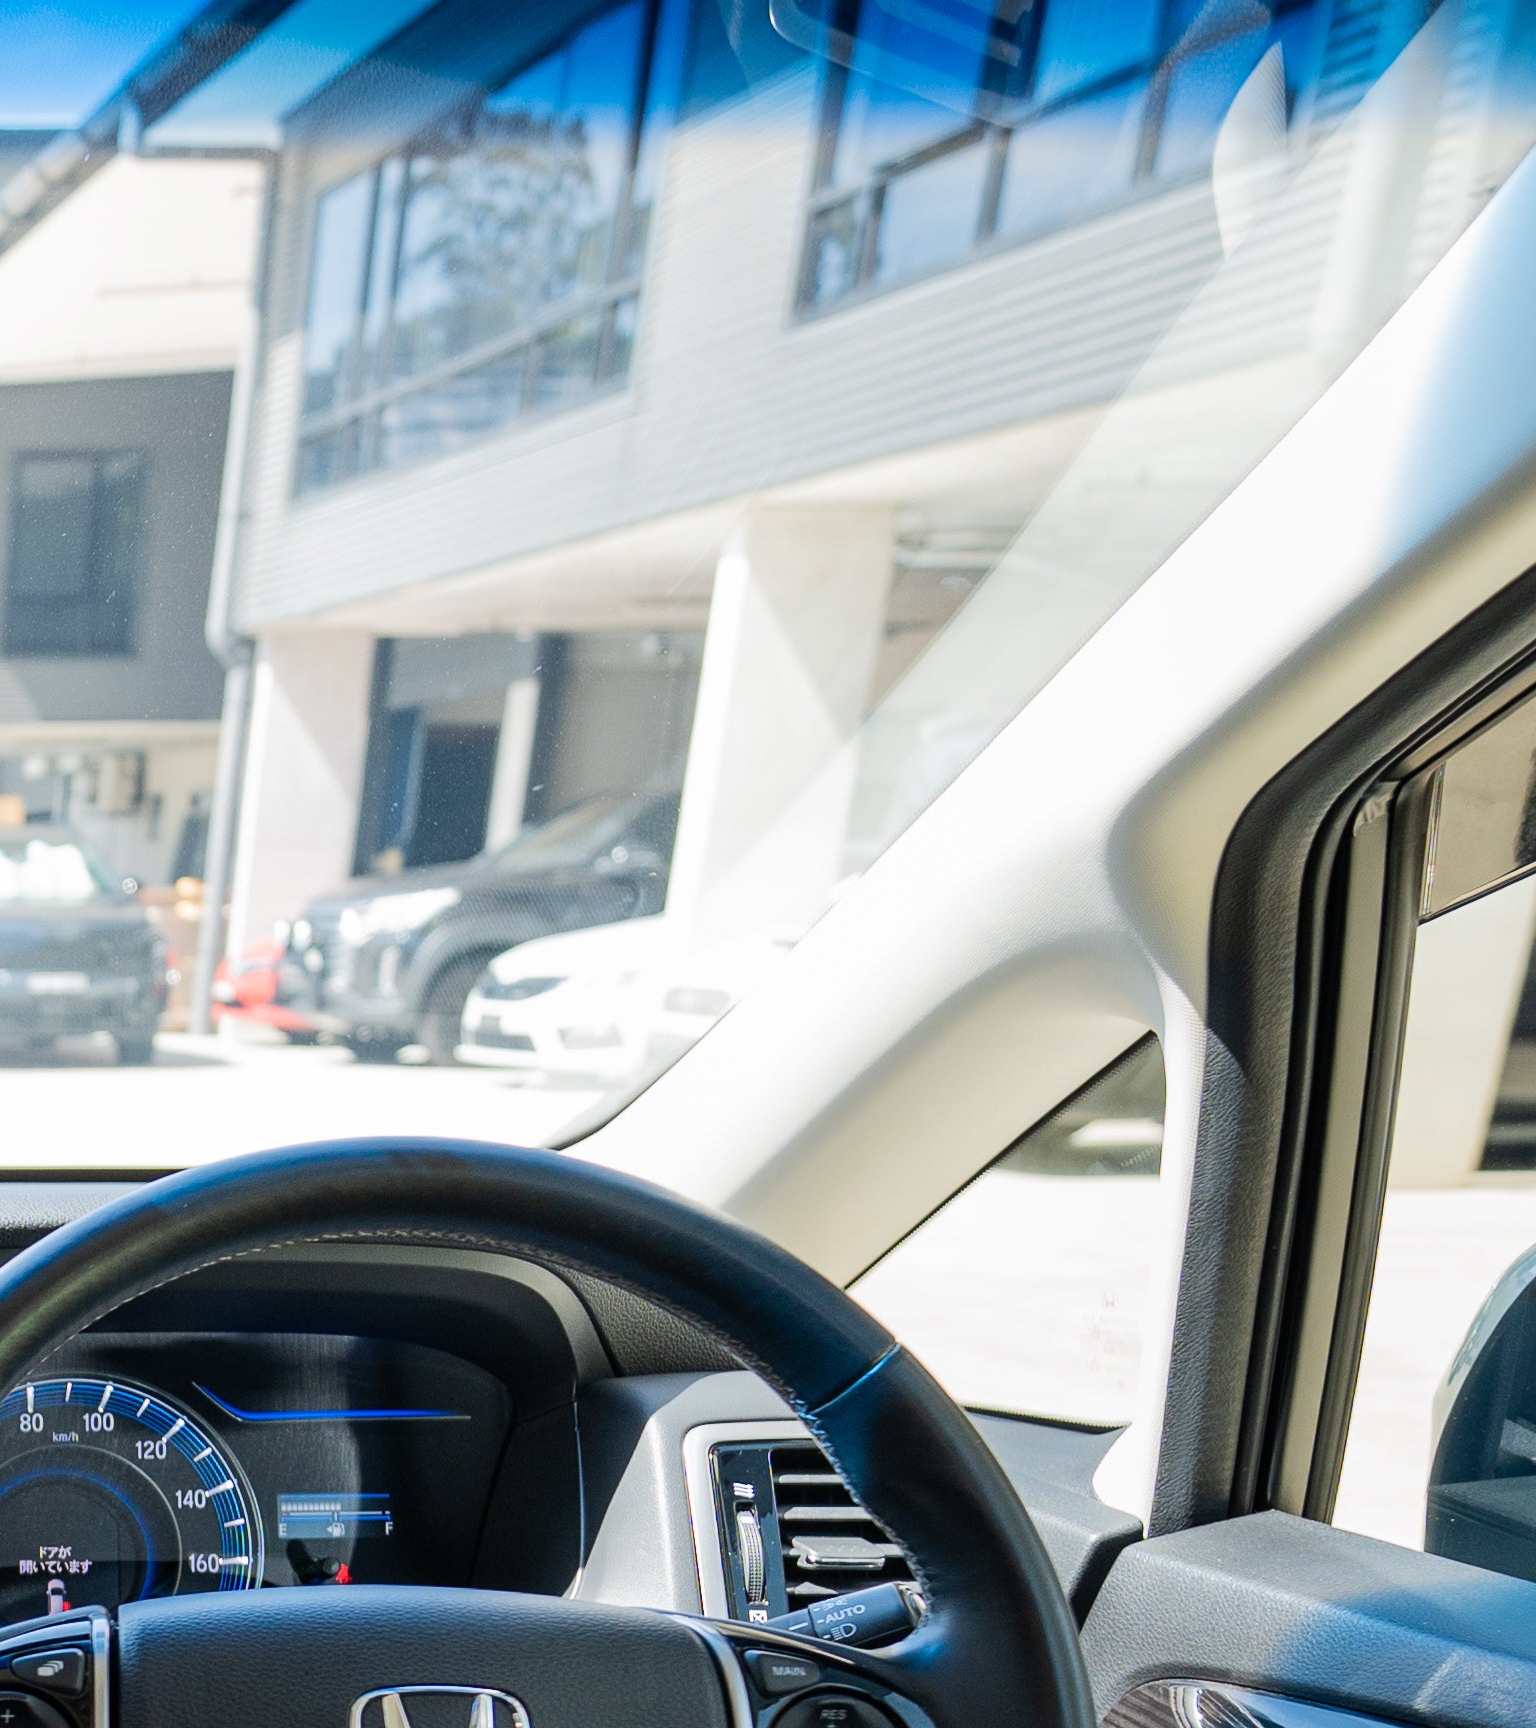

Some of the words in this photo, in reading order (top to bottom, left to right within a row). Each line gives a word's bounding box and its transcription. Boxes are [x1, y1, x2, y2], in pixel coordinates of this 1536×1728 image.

[19, 1413, 44, 1432] 80
[83, 1413, 115, 1432] 100
[52, 1431, 79, 1442] km/h
[135, 1440, 167, 1460] 120
[176, 1489, 207, 1509] 140
[279, 1523, 288, 1536] E
[385, 1521, 394, 1536] F
[39, 1545, 72, 1559] ドアが
[19, 1559, 93, 1574] 開いています
[188, 1554, 220, 1573] 160
[825, 1604, 866, 1624] AUTO
[819, 1709, 848, 1720] RES
